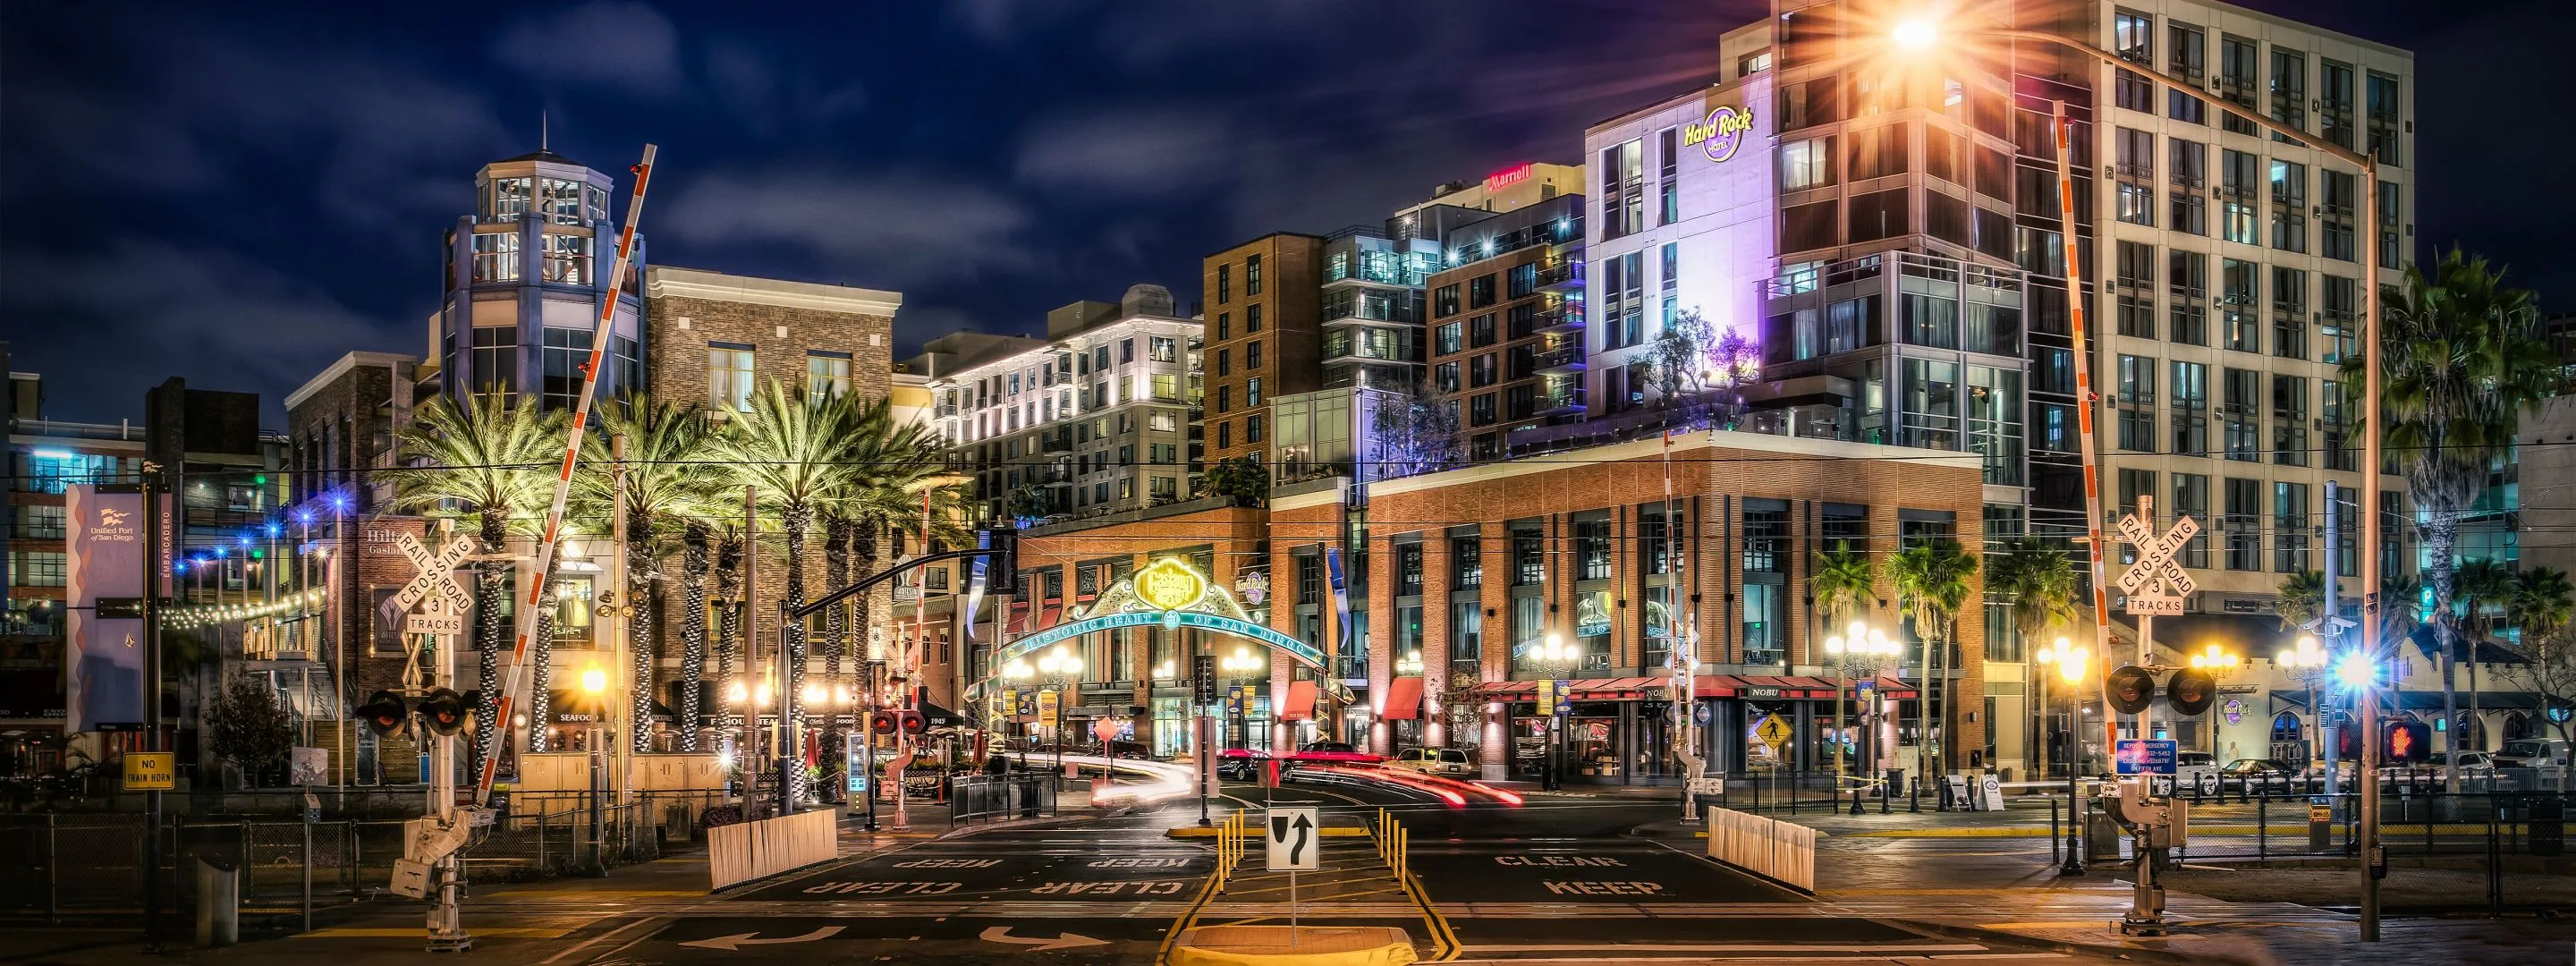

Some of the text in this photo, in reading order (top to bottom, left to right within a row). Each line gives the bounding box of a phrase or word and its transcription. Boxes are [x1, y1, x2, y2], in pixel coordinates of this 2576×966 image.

[1684, 107, 1753, 147] Hard Rock
[1708, 140, 1729, 153] HOTEL
[367, 529, 401, 543] Hilt
[163, 512, 171, 578] EMBARCADERO
[2122, 518, 2192, 593] RAIL ROAD
[2123, 522, 2192, 588] CROSSING
[401, 535, 470, 610] RAIL ROAD
[401, 540, 469, 605] CROSSING
[2151, 580, 2160, 593] 3
[431, 600, 439, 612] 3
[2130, 600, 2181, 610] TRACKS
[411, 619, 460, 630] TRACKS
[1024, 613, 1306, 654] HISTORIC HEART OF SAN DIEGO
[1646, 690, 1673, 698] NOBU
[1752, 689, 1779, 697] NOBU
[560, 714, 598, 722] SEAFOO
[141, 759, 156, 768] NO
[128, 774, 171, 783] TRAIN HORN
[892, 859, 1004, 868] KEEP
[1087, 858, 1191, 868] KEEP
[1495, 856, 1627, 867] CLEAR
[802, 882, 962, 894] CLEAR
[1030, 882, 1201, 894] CLEAR
[1542, 881, 1663, 894] KEEP
